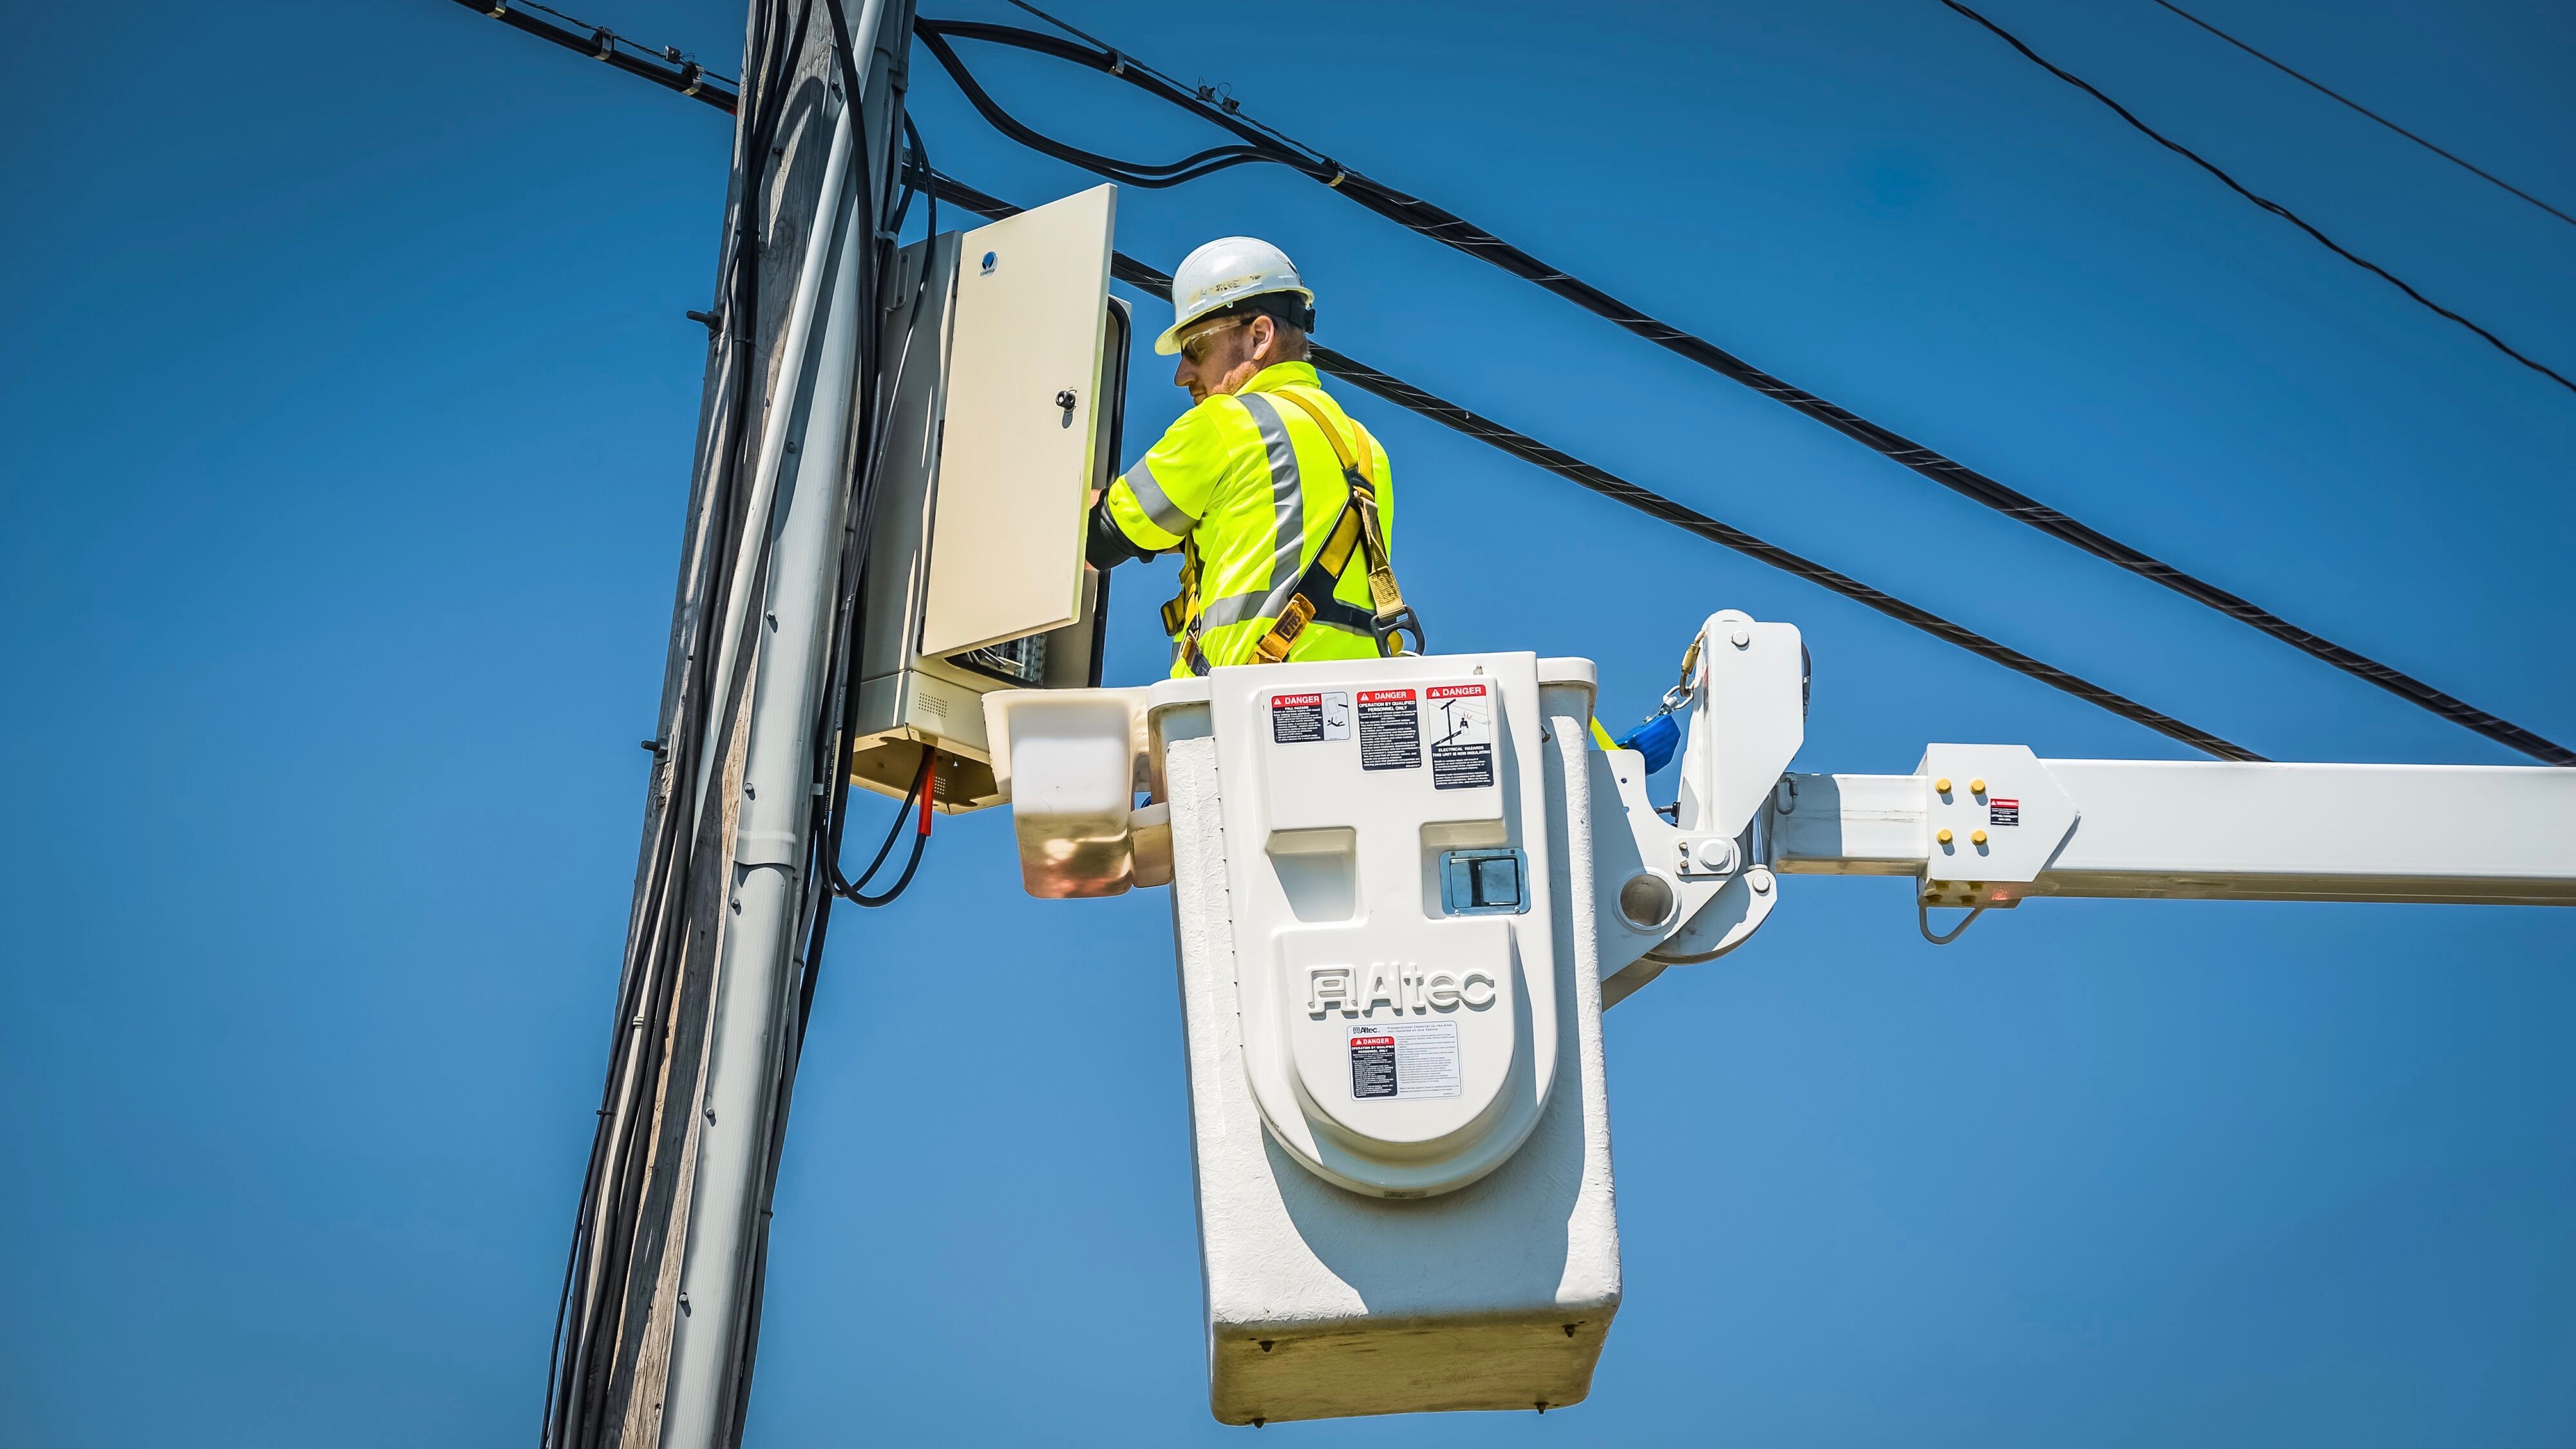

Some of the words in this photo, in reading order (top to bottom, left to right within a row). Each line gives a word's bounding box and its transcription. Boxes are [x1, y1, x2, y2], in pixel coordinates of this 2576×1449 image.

[1282, 614, 1301, 636] SALA
[1374, 691, 1407, 700] DANGER
[1443, 687, 1482, 696] DANGER
[1285, 696, 1320, 705] DANGER
[1361, 961, 1495, 1016] Altec
